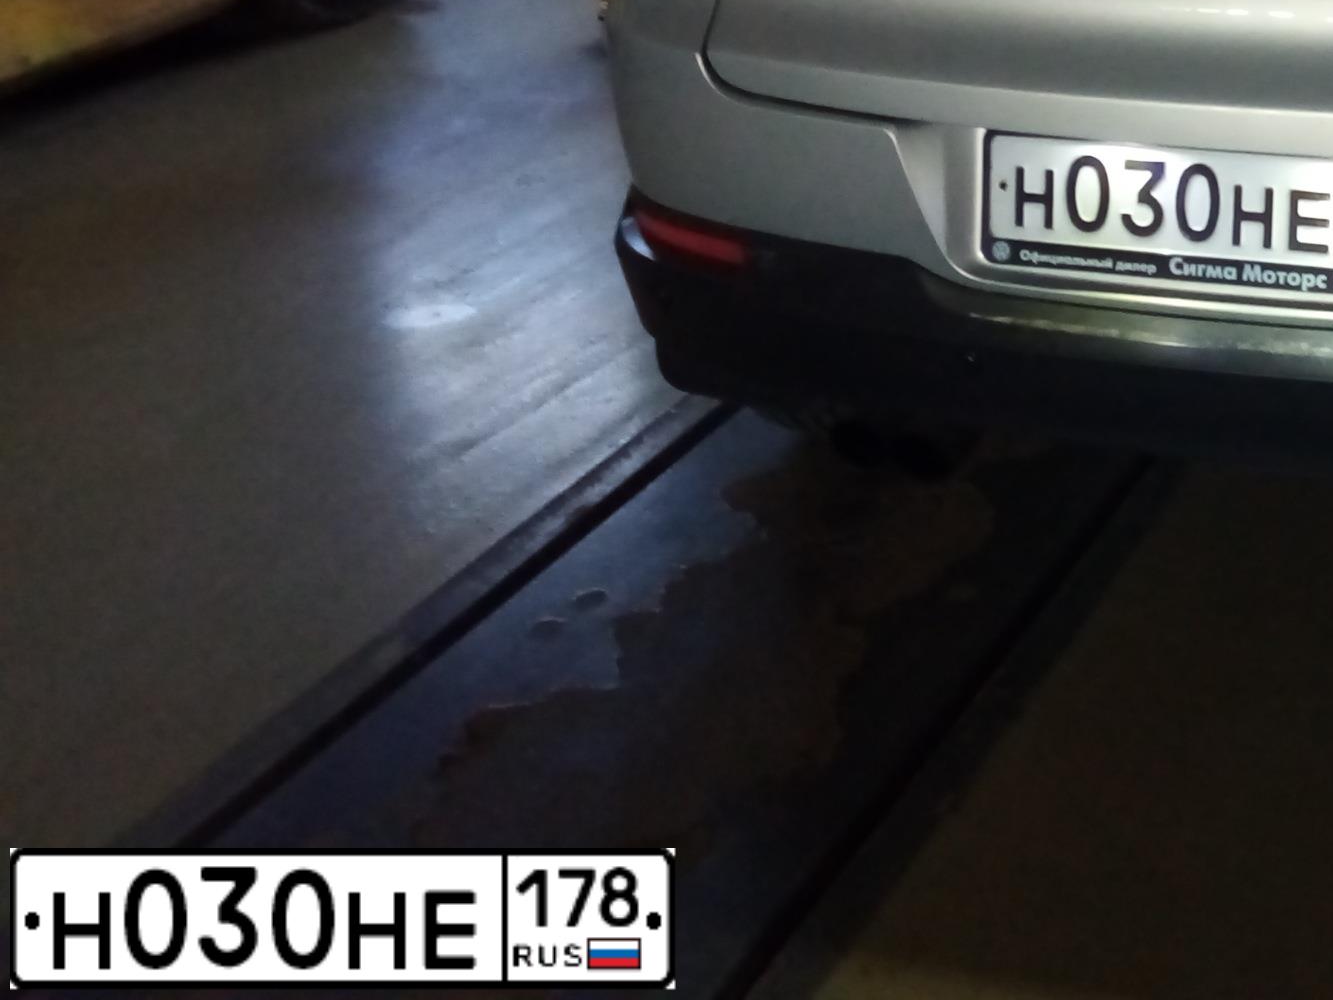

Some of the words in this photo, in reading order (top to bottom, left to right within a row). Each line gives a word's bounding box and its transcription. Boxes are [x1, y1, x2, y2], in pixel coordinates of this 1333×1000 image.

[1019, 249, 1113, 271] Официальный
[1168, 257, 1237, 282] Сигма
[1242, 265, 1328, 292] Моторс
